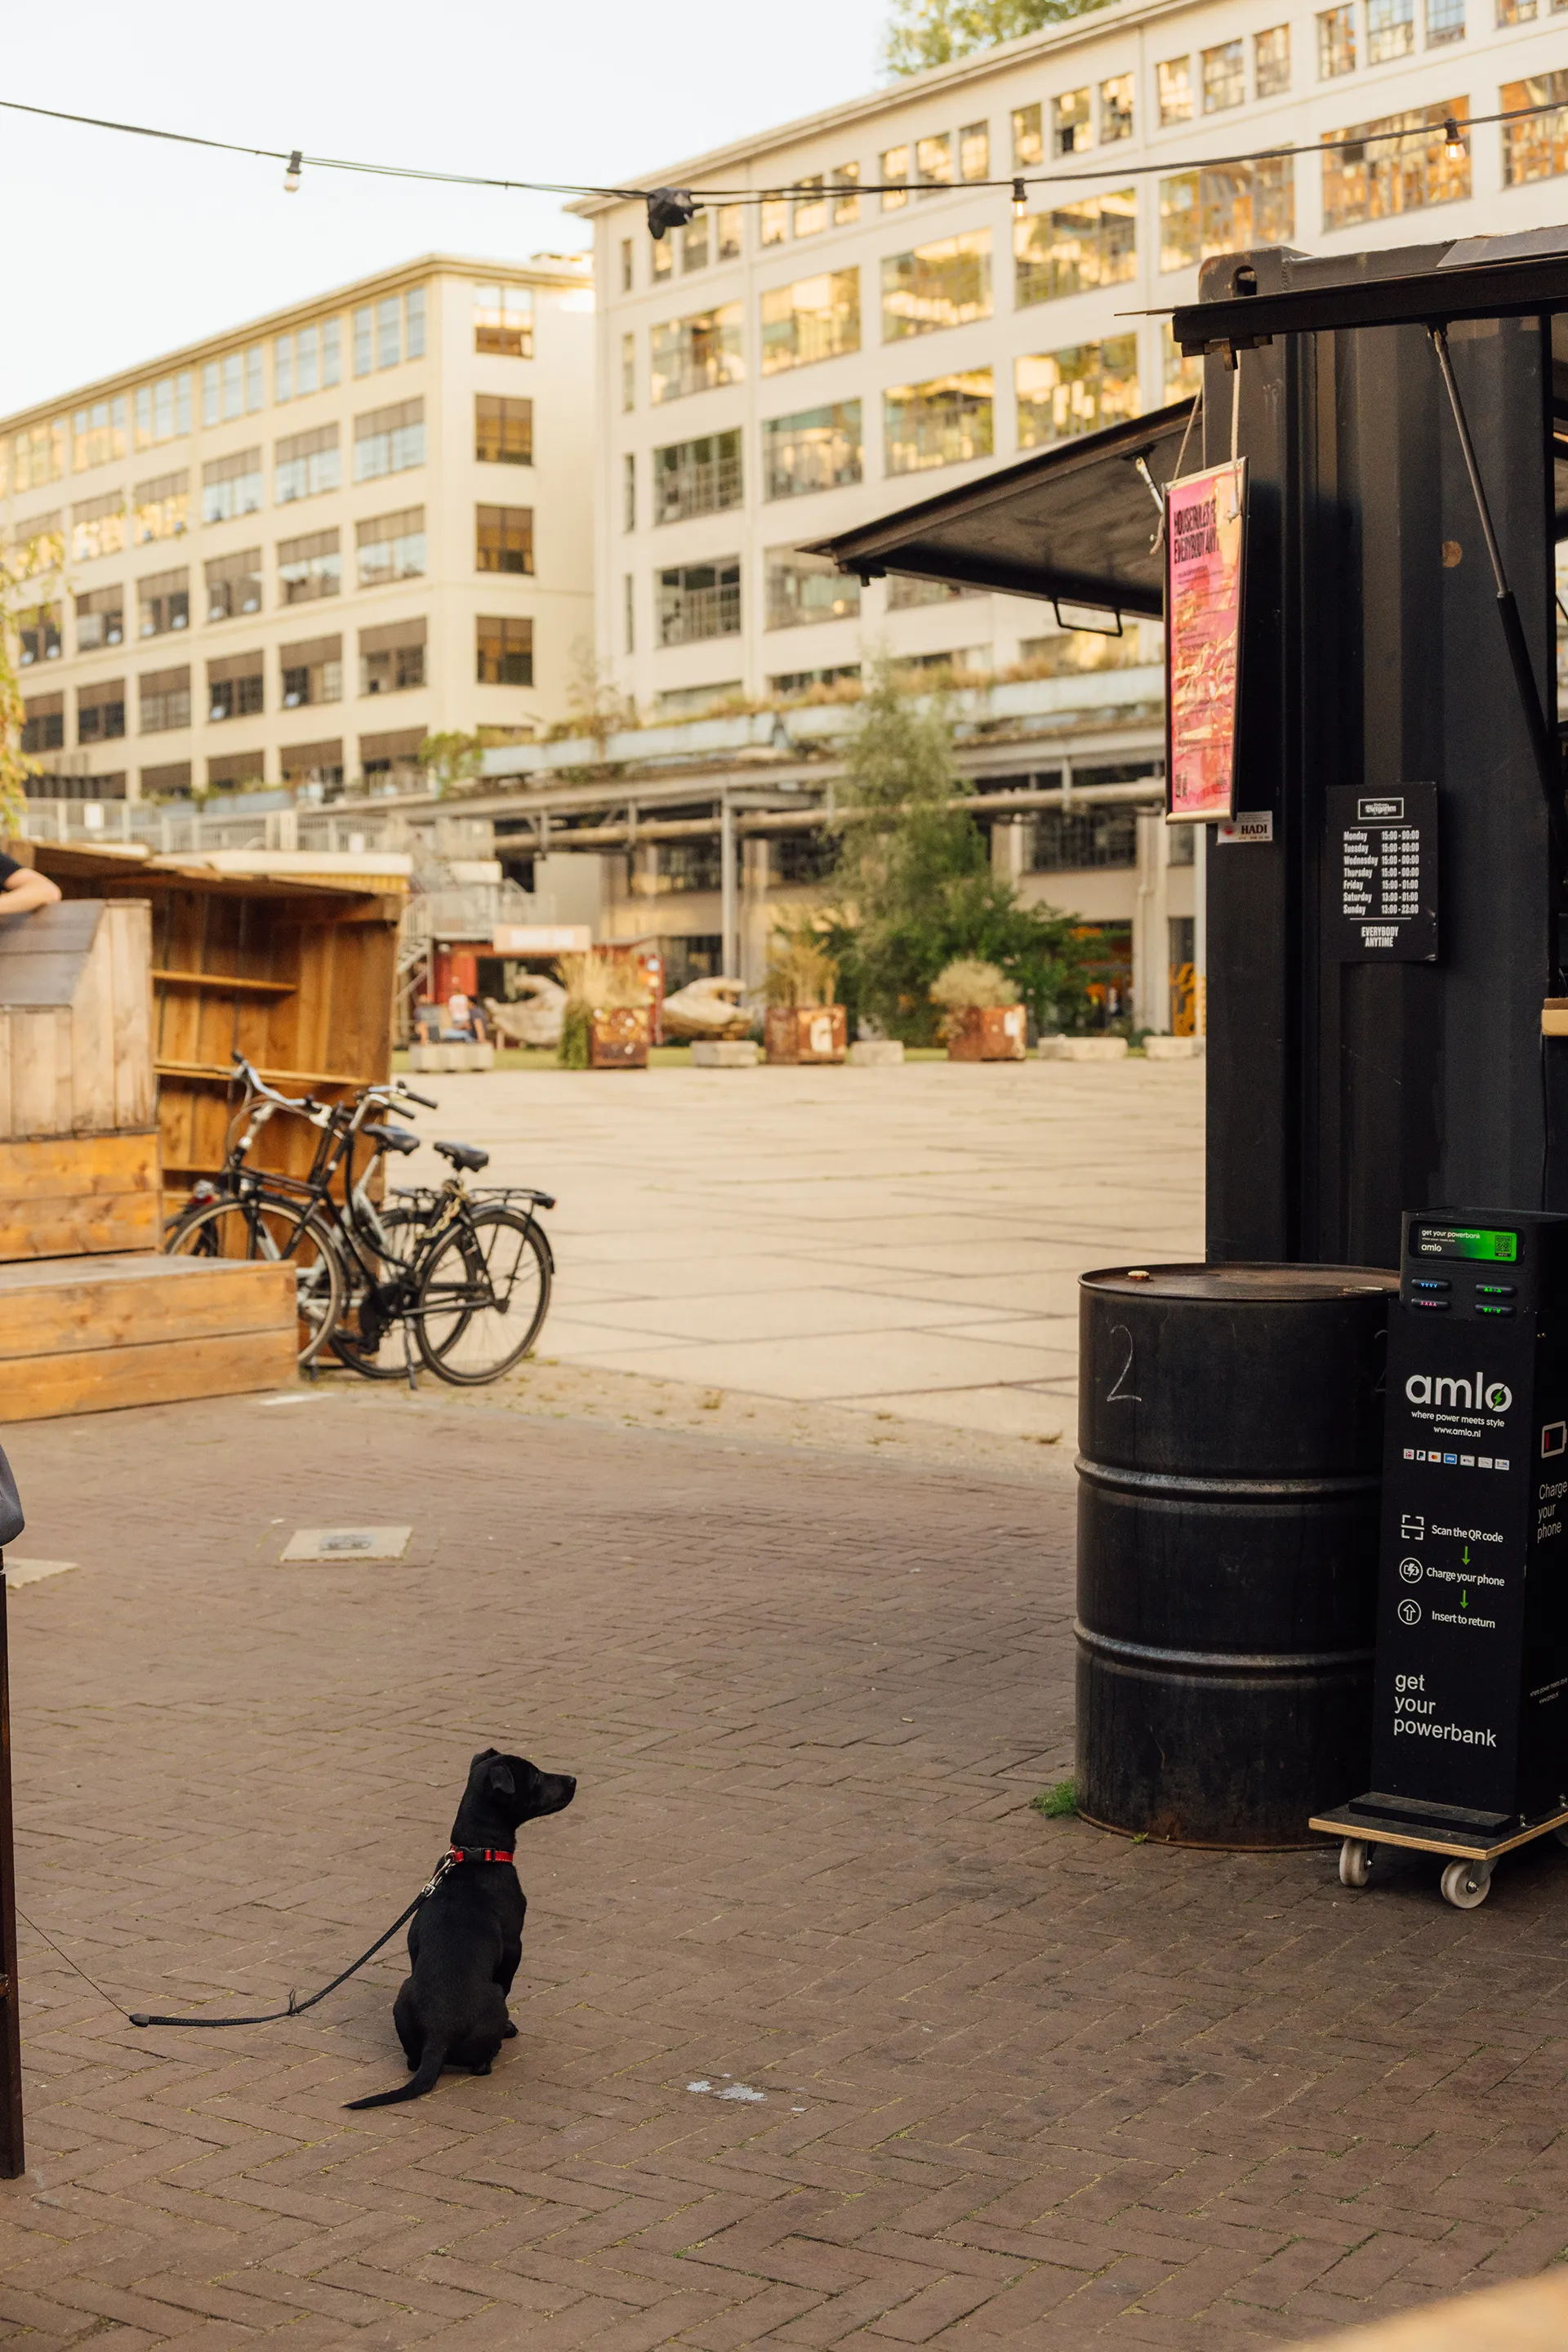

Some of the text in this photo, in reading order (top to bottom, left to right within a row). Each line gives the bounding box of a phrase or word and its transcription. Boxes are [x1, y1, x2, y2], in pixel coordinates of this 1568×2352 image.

[1174, 531, 1205, 564] EVERYBODY
[1241, 824, 1267, 835] HADI
[1343, 831, 1367, 842] Monday
[1382, 831, 1397, 840] 15:00
[1401, 830, 1419, 840] 00:00
[1344, 844, 1369, 853] Tuesday
[1382, 843, 1397, 853] 15:00
[1401, 843, 1419, 852] 00:00
[1344, 856, 1379, 866] Wednesday
[1382, 855, 1397, 865] 15:00
[1401, 855, 1419, 864] 00:00
[1344, 868, 1372, 878] Thursday
[1382, 867, 1397, 877] 15:00
[1401, 867, 1419, 876] 00:00
[1343, 880, 1363, 890] Friday
[1382, 880, 1397, 889] 15:00
[1402, 880, 1419, 889] 01:00
[1343, 893, 1372, 902] Saturday
[1402, 892, 1419, 901] 01:00
[1343, 905, 1365, 915] Sunday
[1401, 904, 1419, 914] 22:00
[1361, 927, 1398, 937] EVERYBODY
[1365, 938, 1393, 947] ANYTIME
[1421, 1244, 1442, 1252] amlo
[1107, 1325, 1143, 1402] 2
[1405, 1372, 1512, 1412] amlo
[1411, 1410, 1504, 1428] where power meets style
[1434, 1426, 1481, 1437] www.amlo.nl
[1539, 1481, 1567, 1499] Charge
[1539, 1504, 1556, 1523] your
[1432, 1525, 1503, 1542] Scan the QR code
[1537, 1521, 1561, 1543] phone
[1427, 1567, 1505, 1586] Charge your phone
[1432, 1611, 1495, 1628] Insert to return
[1396, 1674, 1425, 1692] get
[1394, 1696, 1436, 1714] your
[1394, 1718, 1497, 1748] powerbank
